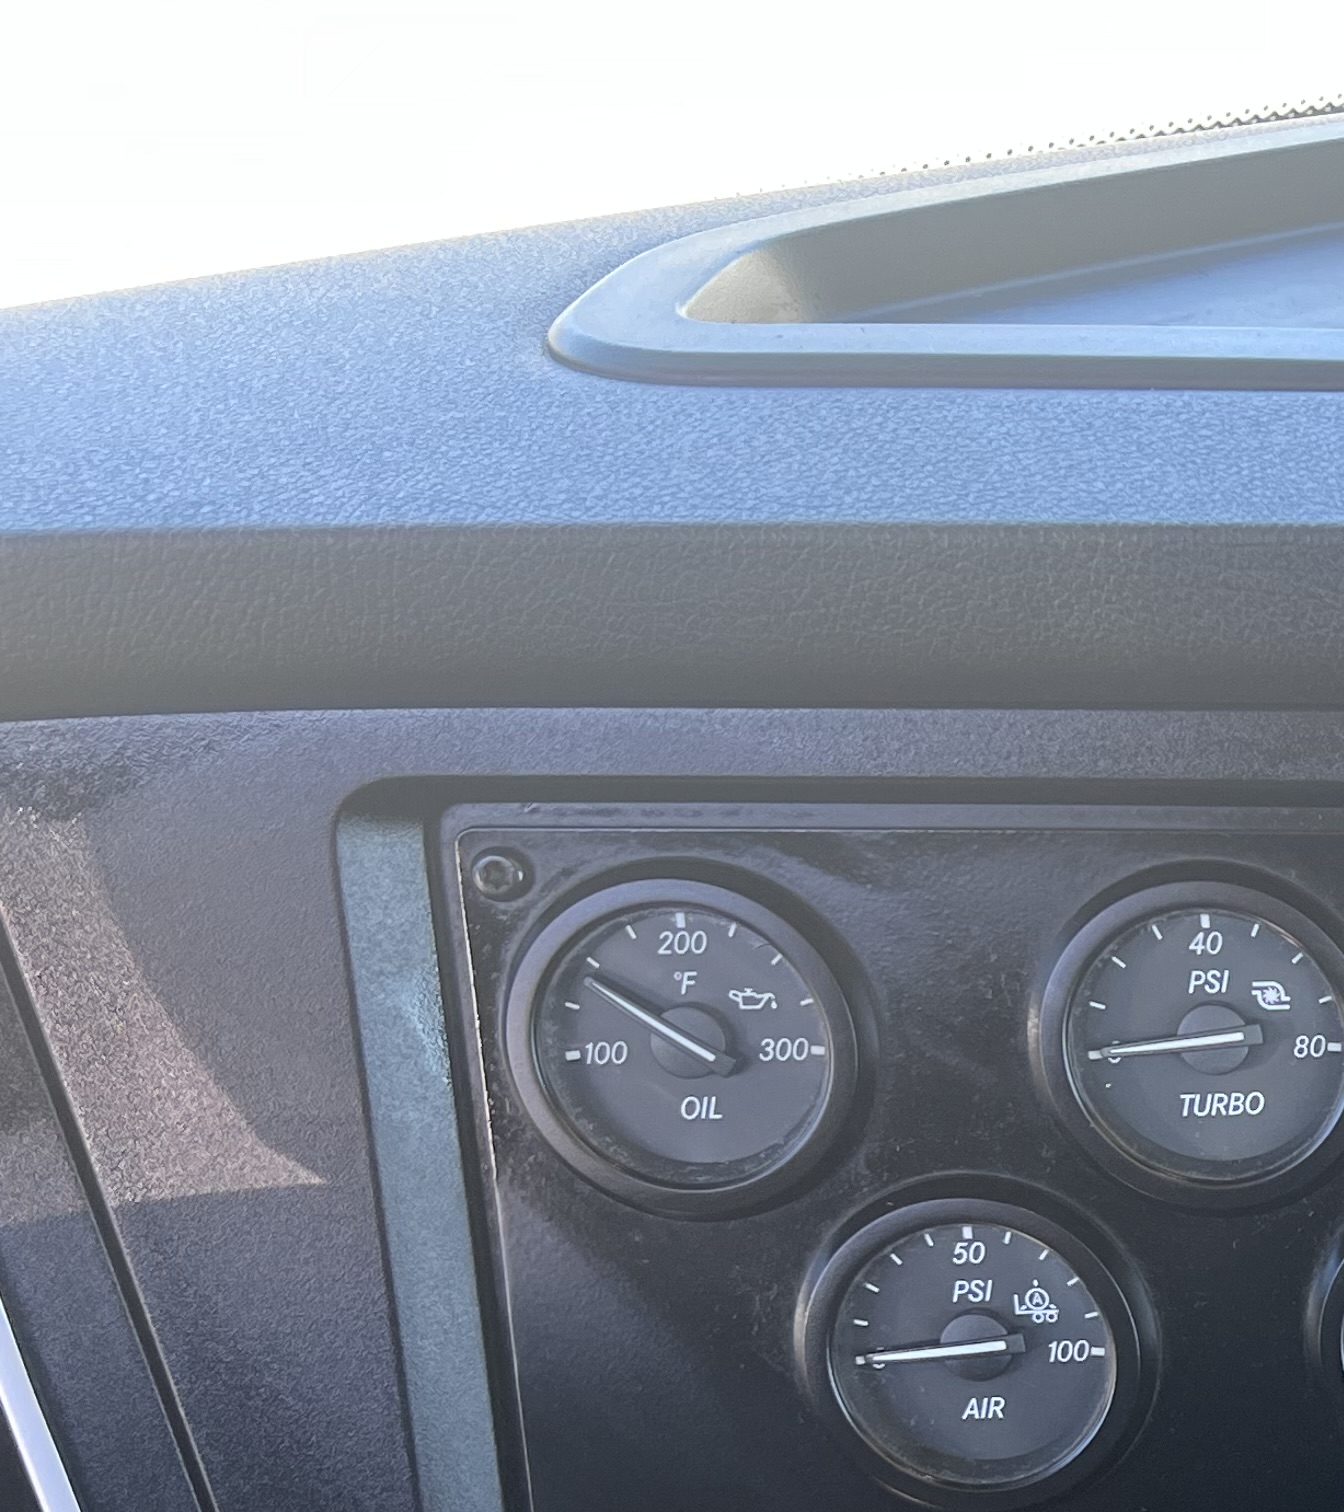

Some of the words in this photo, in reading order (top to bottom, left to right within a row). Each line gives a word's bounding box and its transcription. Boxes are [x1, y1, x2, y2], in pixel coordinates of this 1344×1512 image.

[657, 931, 707, 955] 200
[1189, 932, 1223, 955] 40
[1188, 970, 1229, 994] PSI
[584, 1041, 628, 1065] 100
[759, 1037, 809, 1062] 300
[1293, 1035, 1326, 1058] 80
[680, 1096, 723, 1120] OIL
[1179, 1091, 1265, 1117] TURBO
[952, 1242, 986, 1265] 50
[952, 1279, 993, 1303] PSI
[1048, 1339, 1090, 1363] 100
[962, 1396, 1006, 1420] AIR
